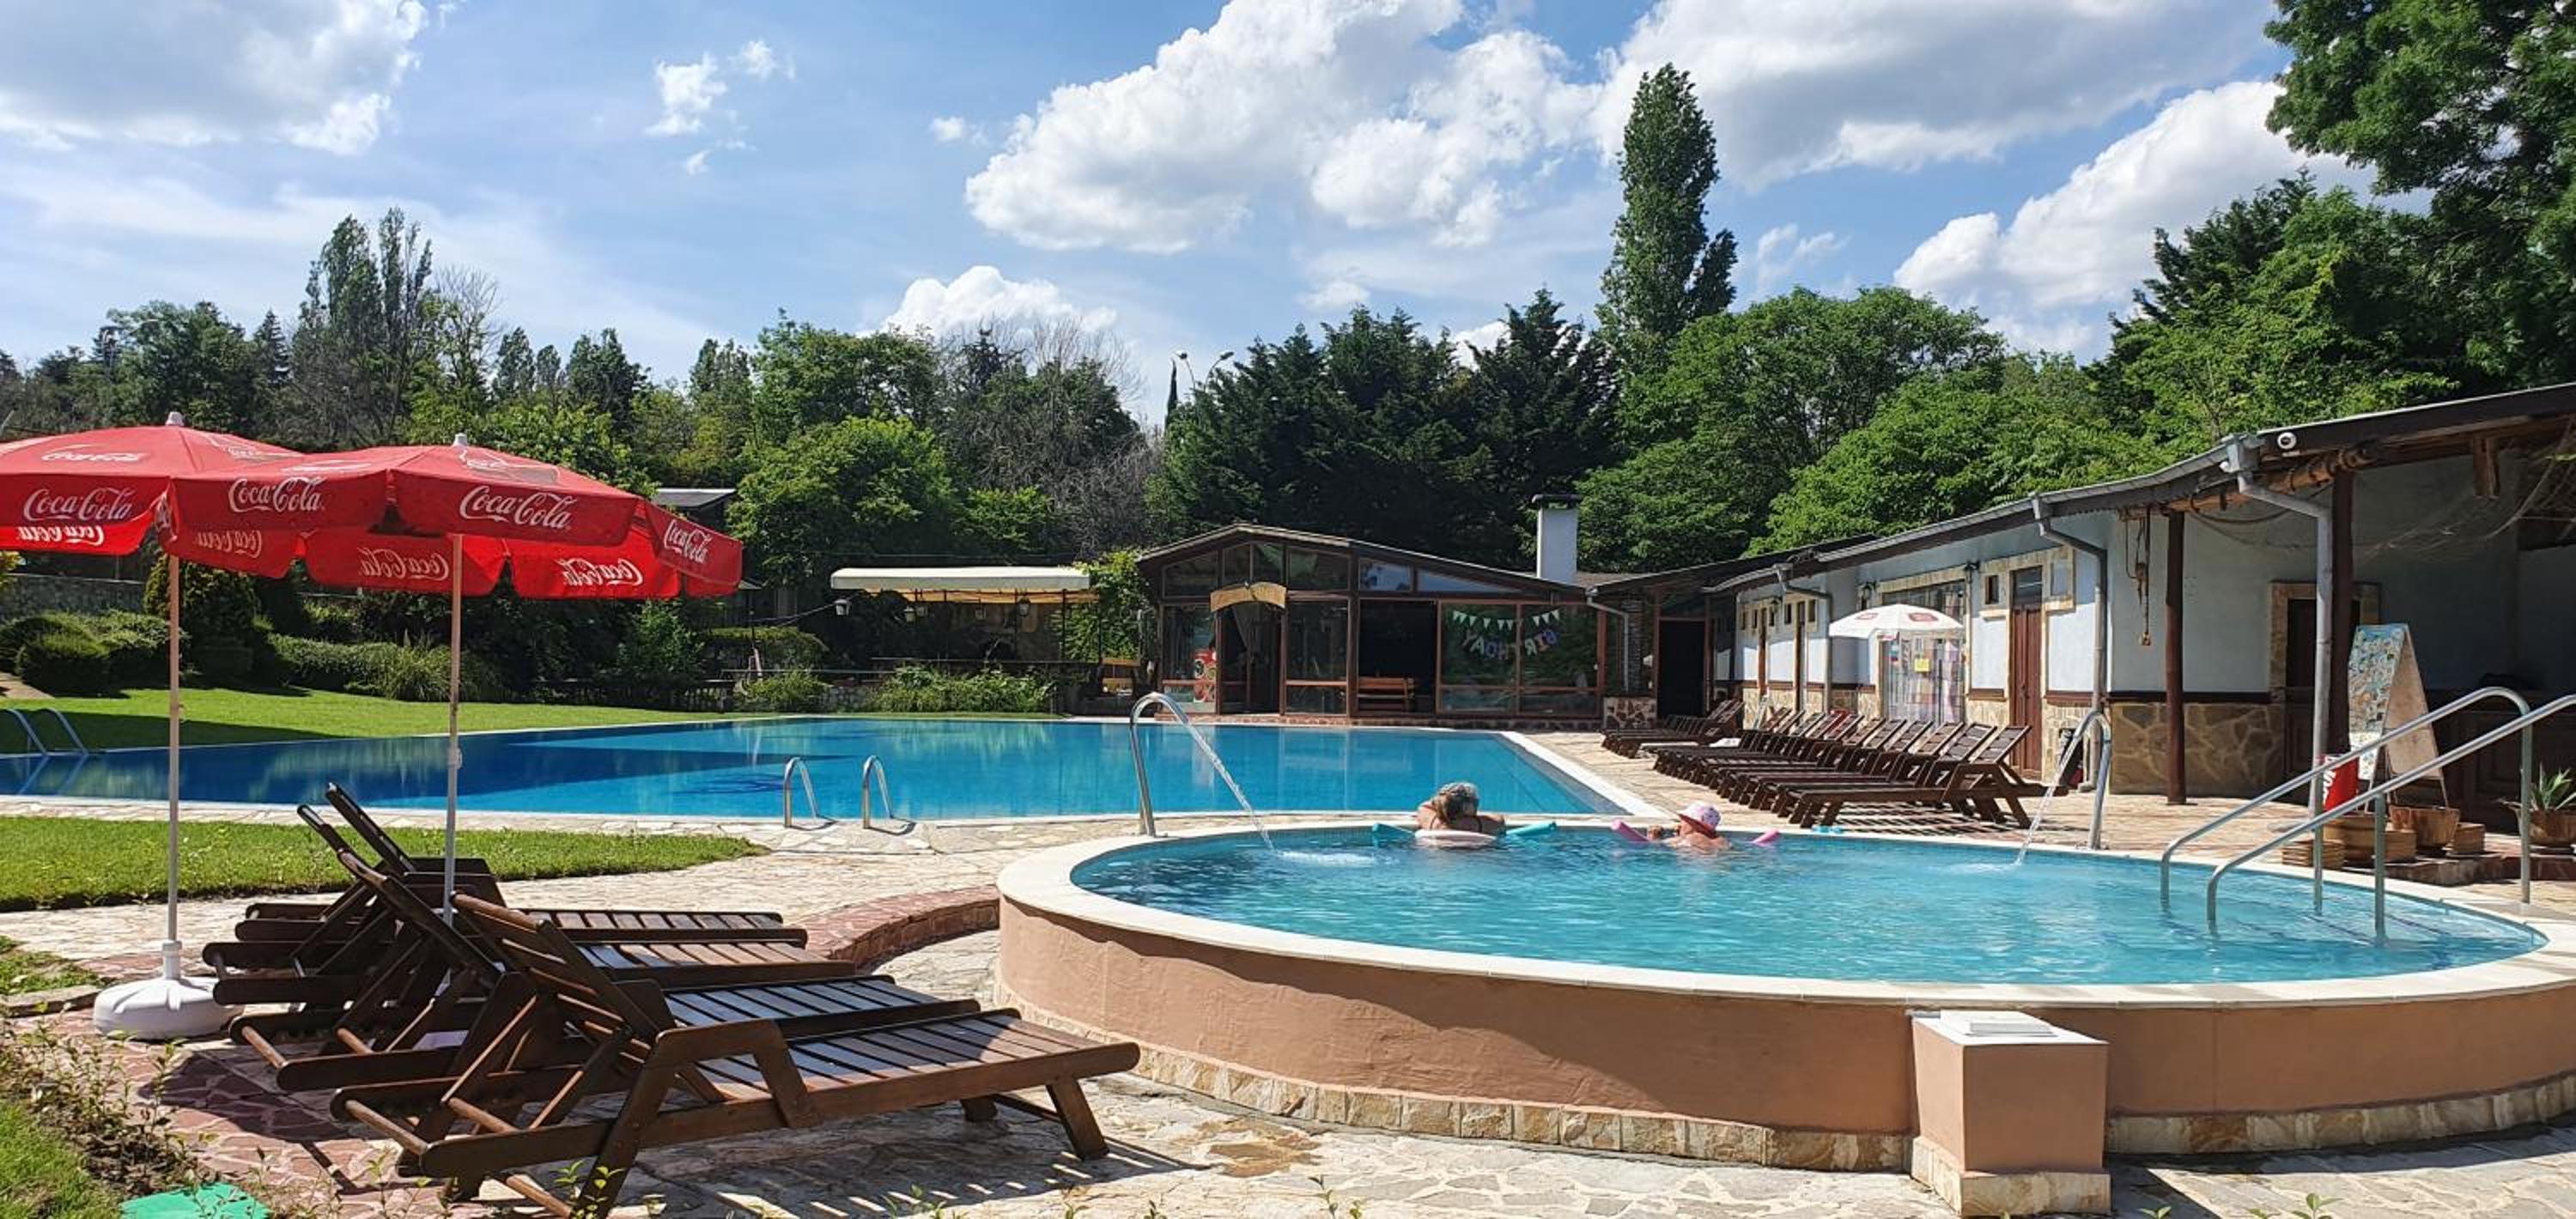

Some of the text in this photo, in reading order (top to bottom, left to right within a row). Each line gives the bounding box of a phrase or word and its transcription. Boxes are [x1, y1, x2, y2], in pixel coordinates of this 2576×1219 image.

[23, 487, 137, 522] Coca-Cola
[228, 476, 329, 513] Coca-Cola
[459, 485, 577, 530] Coca-Cola
[664, 519, 712, 564] Coca-Cola
